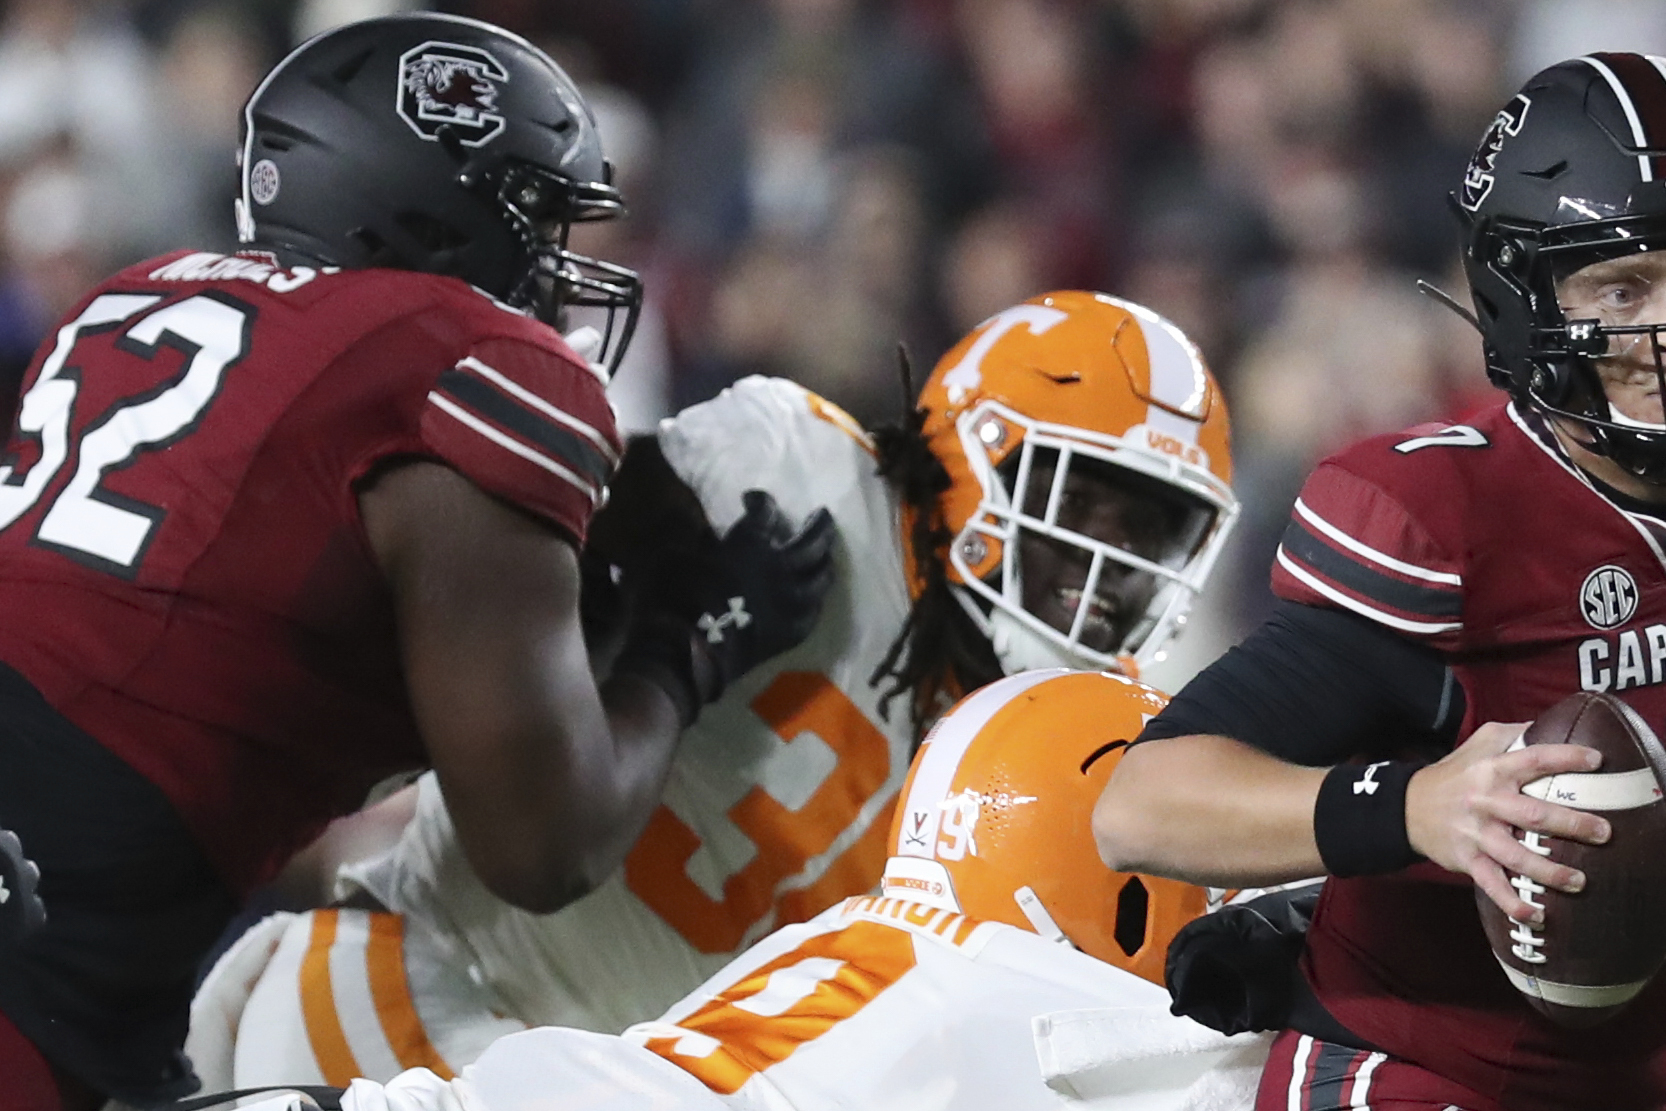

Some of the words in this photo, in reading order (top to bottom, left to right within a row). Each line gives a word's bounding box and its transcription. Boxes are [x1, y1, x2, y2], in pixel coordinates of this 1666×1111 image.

[0, 294, 246, 567] 52
[1394, 424, 1489, 453] 7
[1585, 571, 1634, 625] SEC
[624, 671, 902, 954] 3
